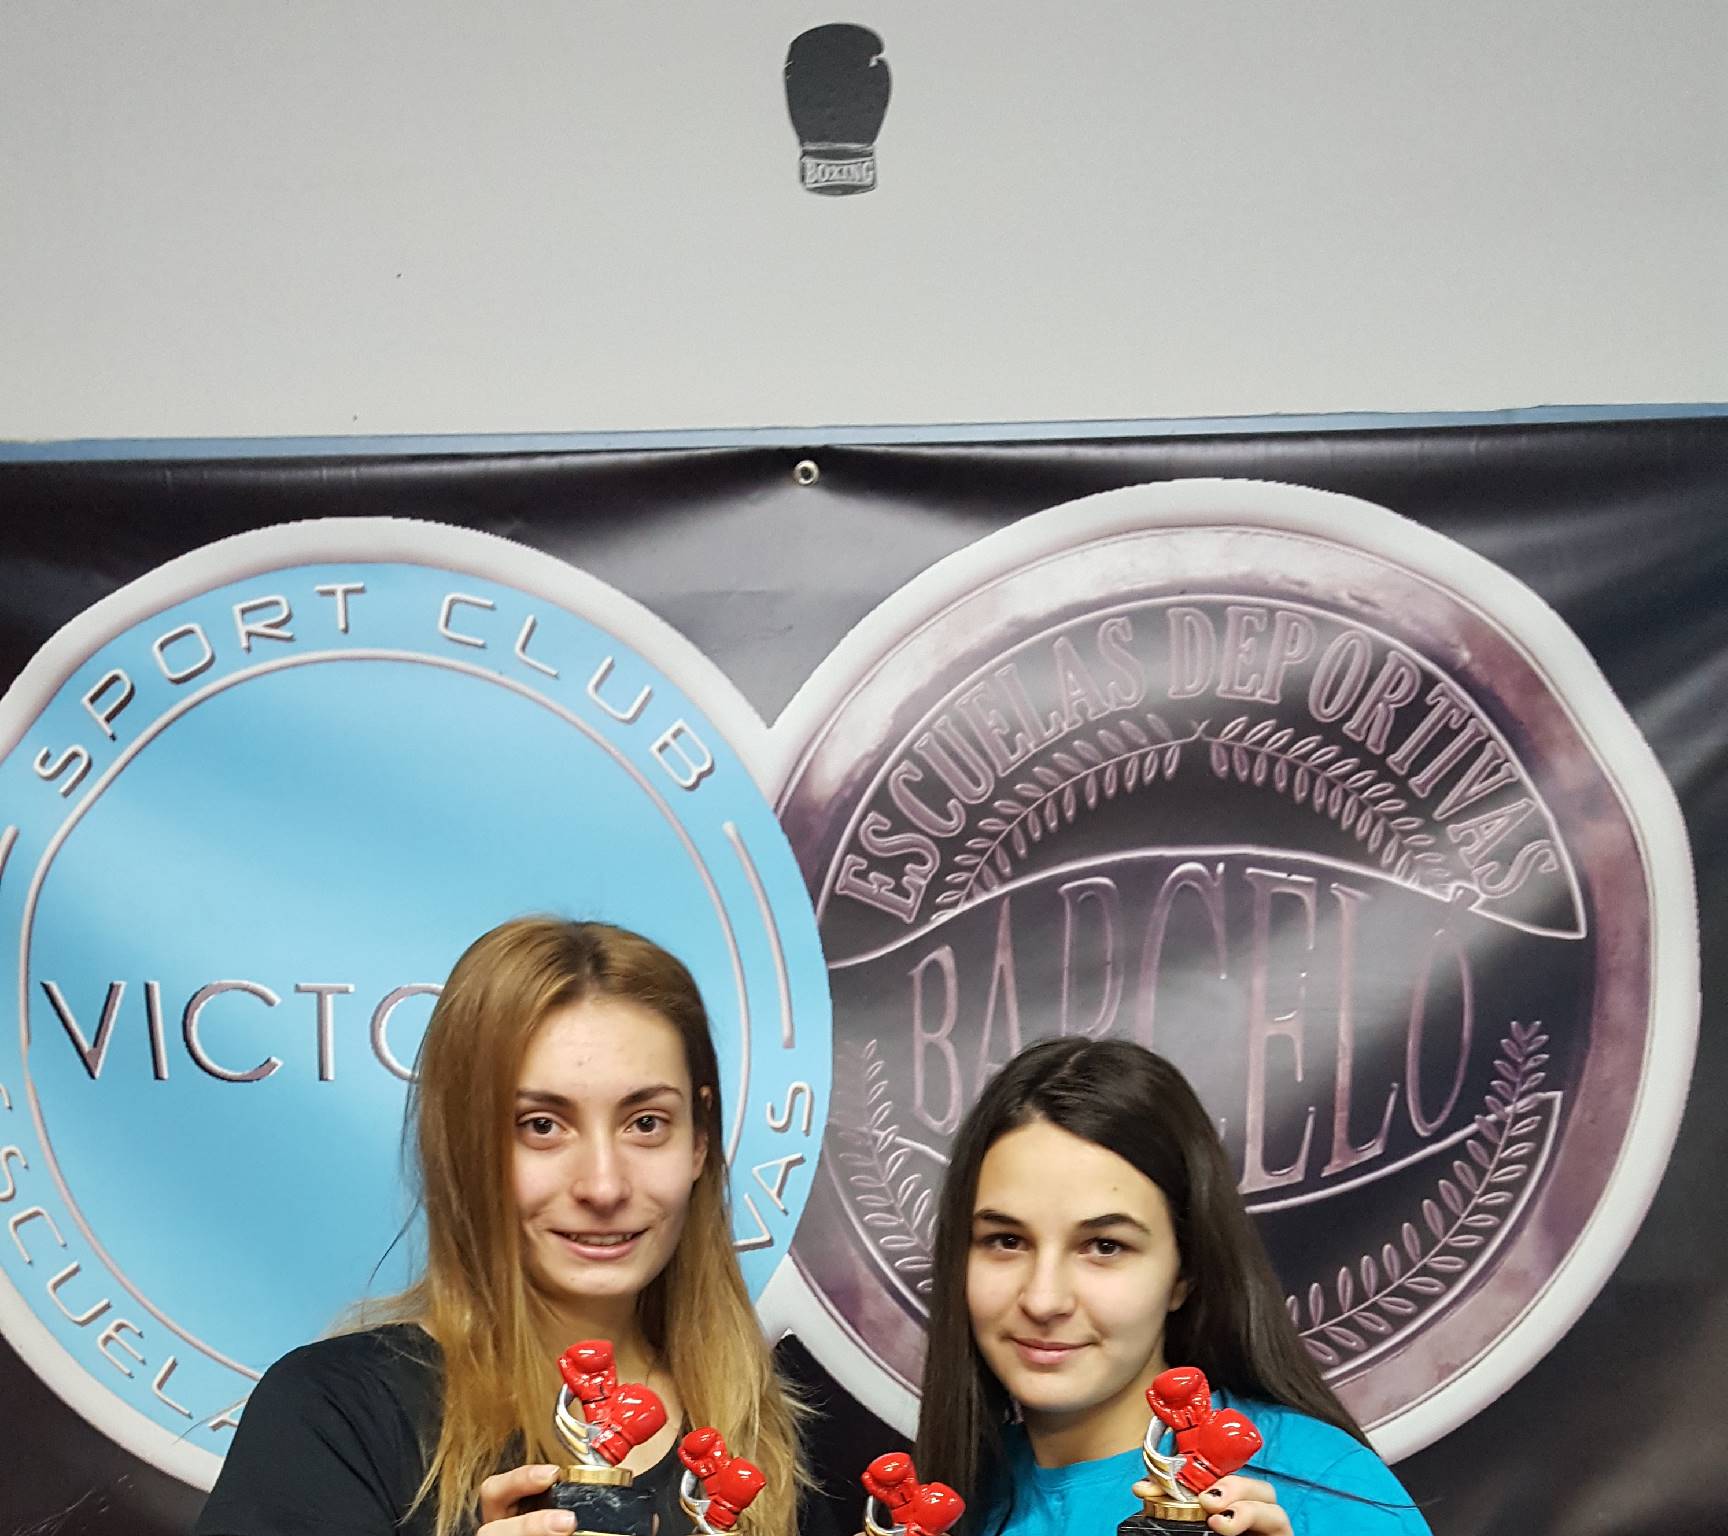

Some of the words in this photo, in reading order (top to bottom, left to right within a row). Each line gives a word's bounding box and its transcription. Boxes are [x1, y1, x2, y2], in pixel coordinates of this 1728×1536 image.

[33, 582, 369, 798] SPORT
[438, 592, 715, 791] CLUB
[836, 616, 1146, 924] ESCUELAS
[1166, 606, 1561, 899] DEPORTIVAS
[40, 979, 444, 1083] VICTO
[731, 1081, 814, 1253] VAS
